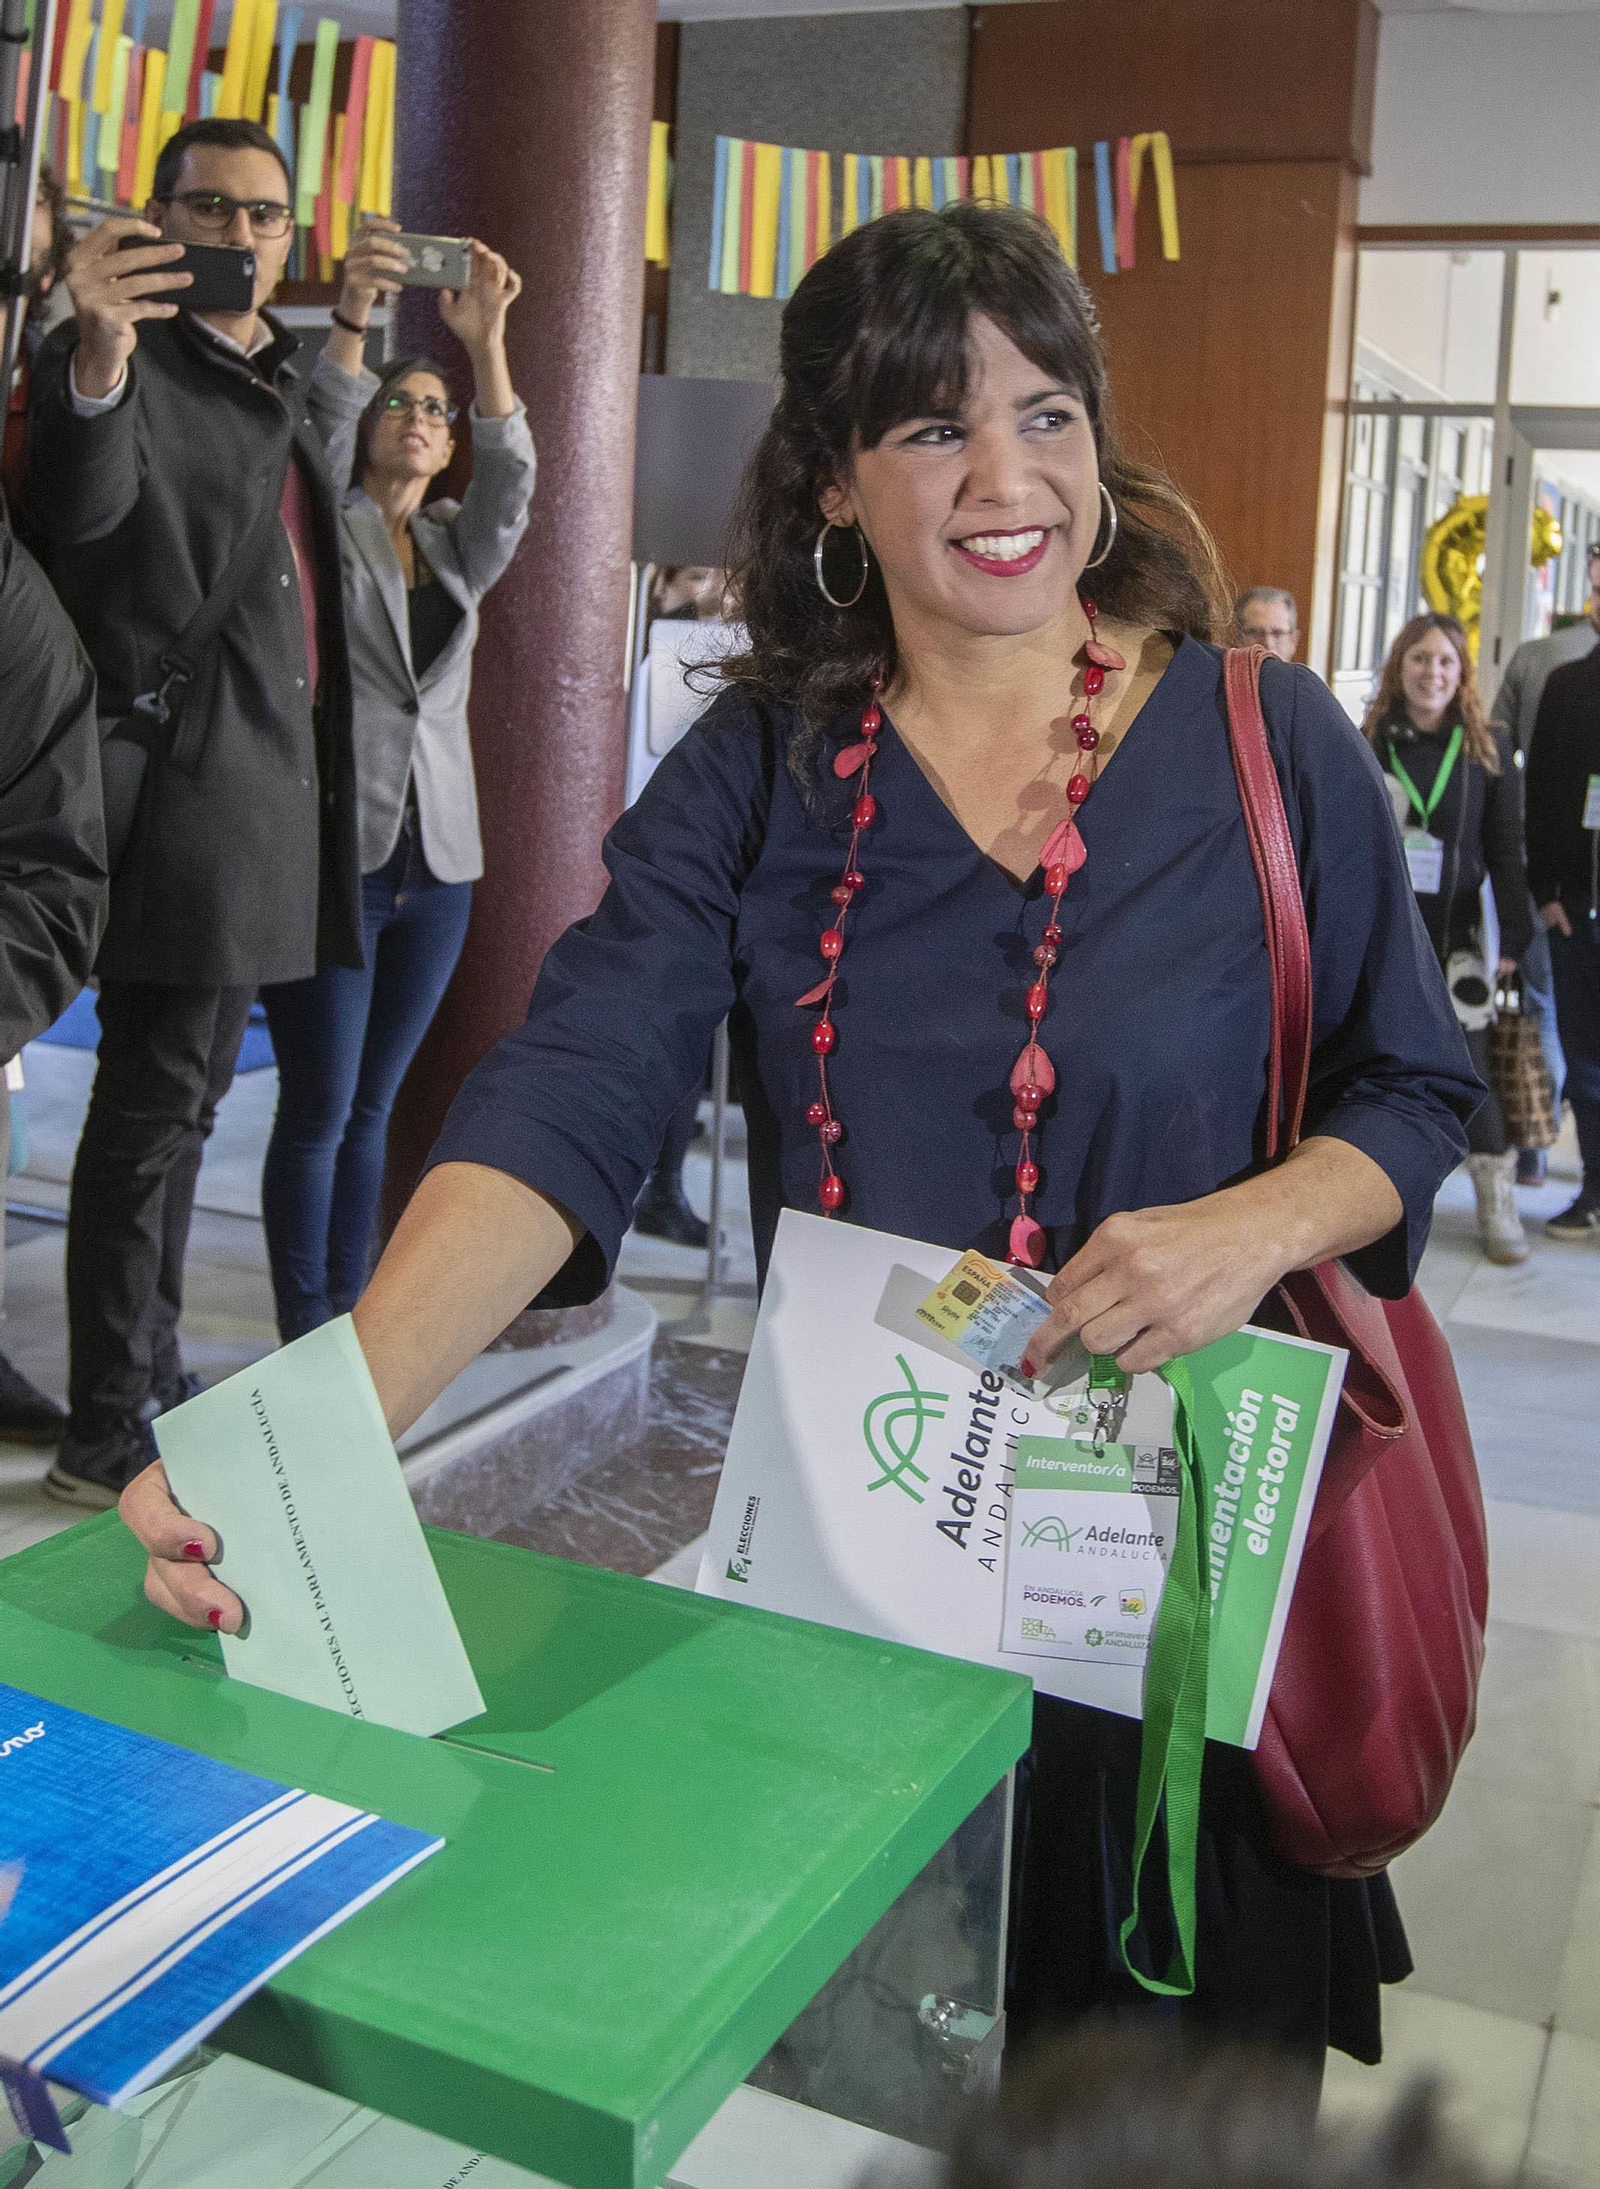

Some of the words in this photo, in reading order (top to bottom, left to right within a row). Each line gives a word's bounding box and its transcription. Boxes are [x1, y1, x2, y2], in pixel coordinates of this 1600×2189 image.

[961, 1265, 991, 1289] ESPAÑA
[250, 1388, 287, 1476] ANDALUCÍA
[936, 1369, 1004, 1550] Adelante
[1025, 1455, 1127, 1478] Interventor/a
[278, 1479, 293, 1501] DE
[977, 1387, 1031, 1573] ANDALUCÍ
[1243, 1393, 1301, 1556] electoral
[285, 1503, 326, 1611] PARLAMENTO
[736, 1495, 757, 1554] ELECCIONES
[1085, 1525, 1164, 1547] Adelante
[320, 1611, 335, 1632] AL
[327, 1635, 365, 1721] ECCIONES
